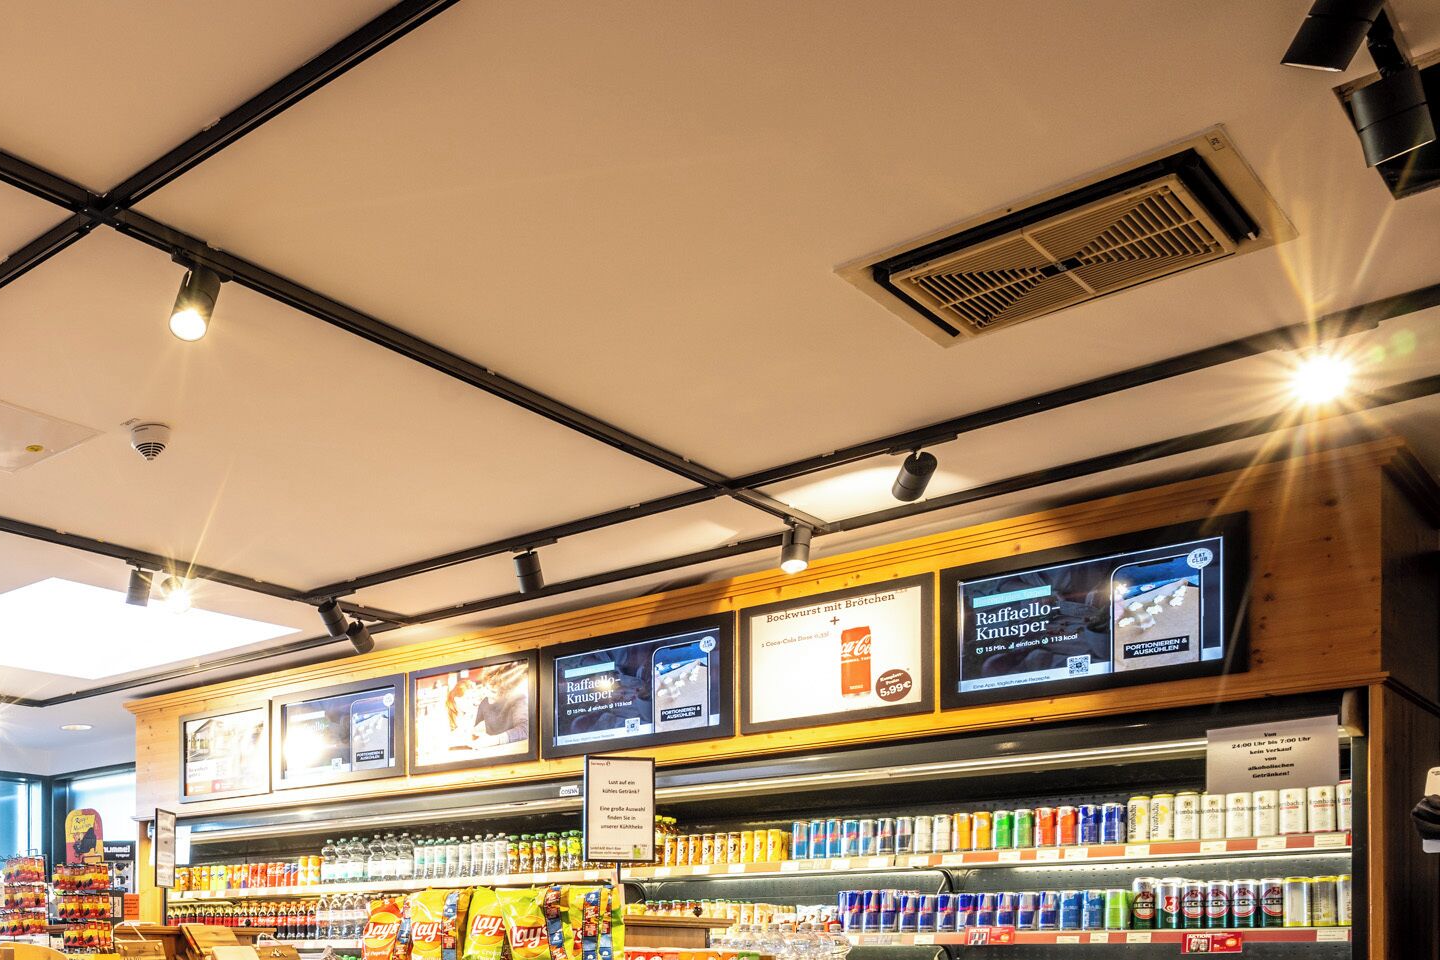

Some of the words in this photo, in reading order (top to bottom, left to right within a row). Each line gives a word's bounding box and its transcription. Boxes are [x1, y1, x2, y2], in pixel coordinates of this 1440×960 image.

[766, 605, 821, 624] Bockwurst
[824, 602, 842, 613] mit
[845, 591, 895, 609] Brötchen
[975, 621, 1050, 643] Knusper
[766, 638, 797, 648] Coca-Cola
[1015, 638, 1040, 649] einfach
[1051, 635, 1063, 643] 113
[1063, 633, 1078, 642] kcal
[1125, 638, 1179, 651] PORTIONIEREN
[1133, 644, 1179, 656] AUSKÜHLEN
[566, 688, 614, 704] Knusper
[661, 706, 696, 717] PORTIONIEREN
[666, 711, 696, 720] AUSKÜHLEN
[1265, 746, 1292, 754] Verkauf
[1247, 762, 1295, 771] alkoholischen
[1252, 771, 1290, 779] Getränken!
[1128, 804, 1137, 834] Krombacher
